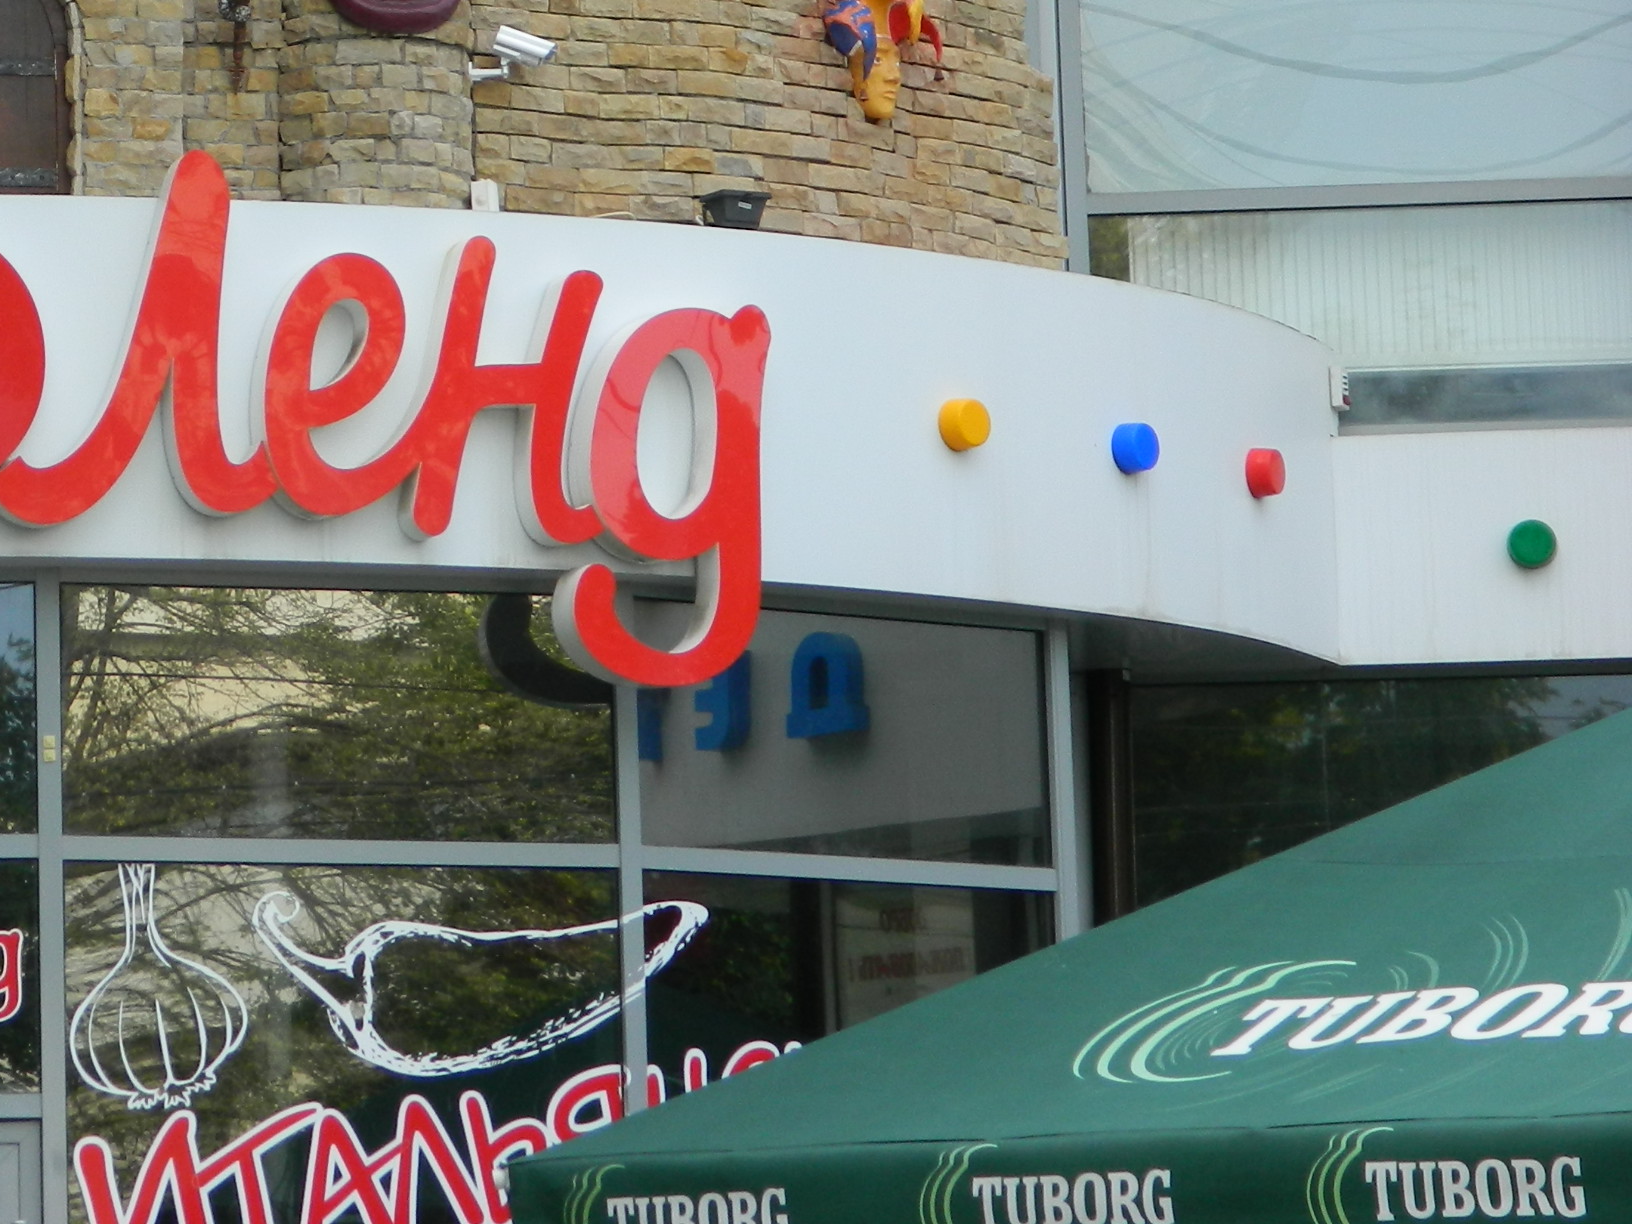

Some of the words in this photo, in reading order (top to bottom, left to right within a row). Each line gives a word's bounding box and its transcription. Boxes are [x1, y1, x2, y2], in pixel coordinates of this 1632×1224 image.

[1210, 980, 1632, 1057] TUBOR
[606, 1187, 789, 1224] TUBORG
[972, 1168, 1175, 1224] TUBORG
[1365, 1155, 1588, 1222] TUBORG
